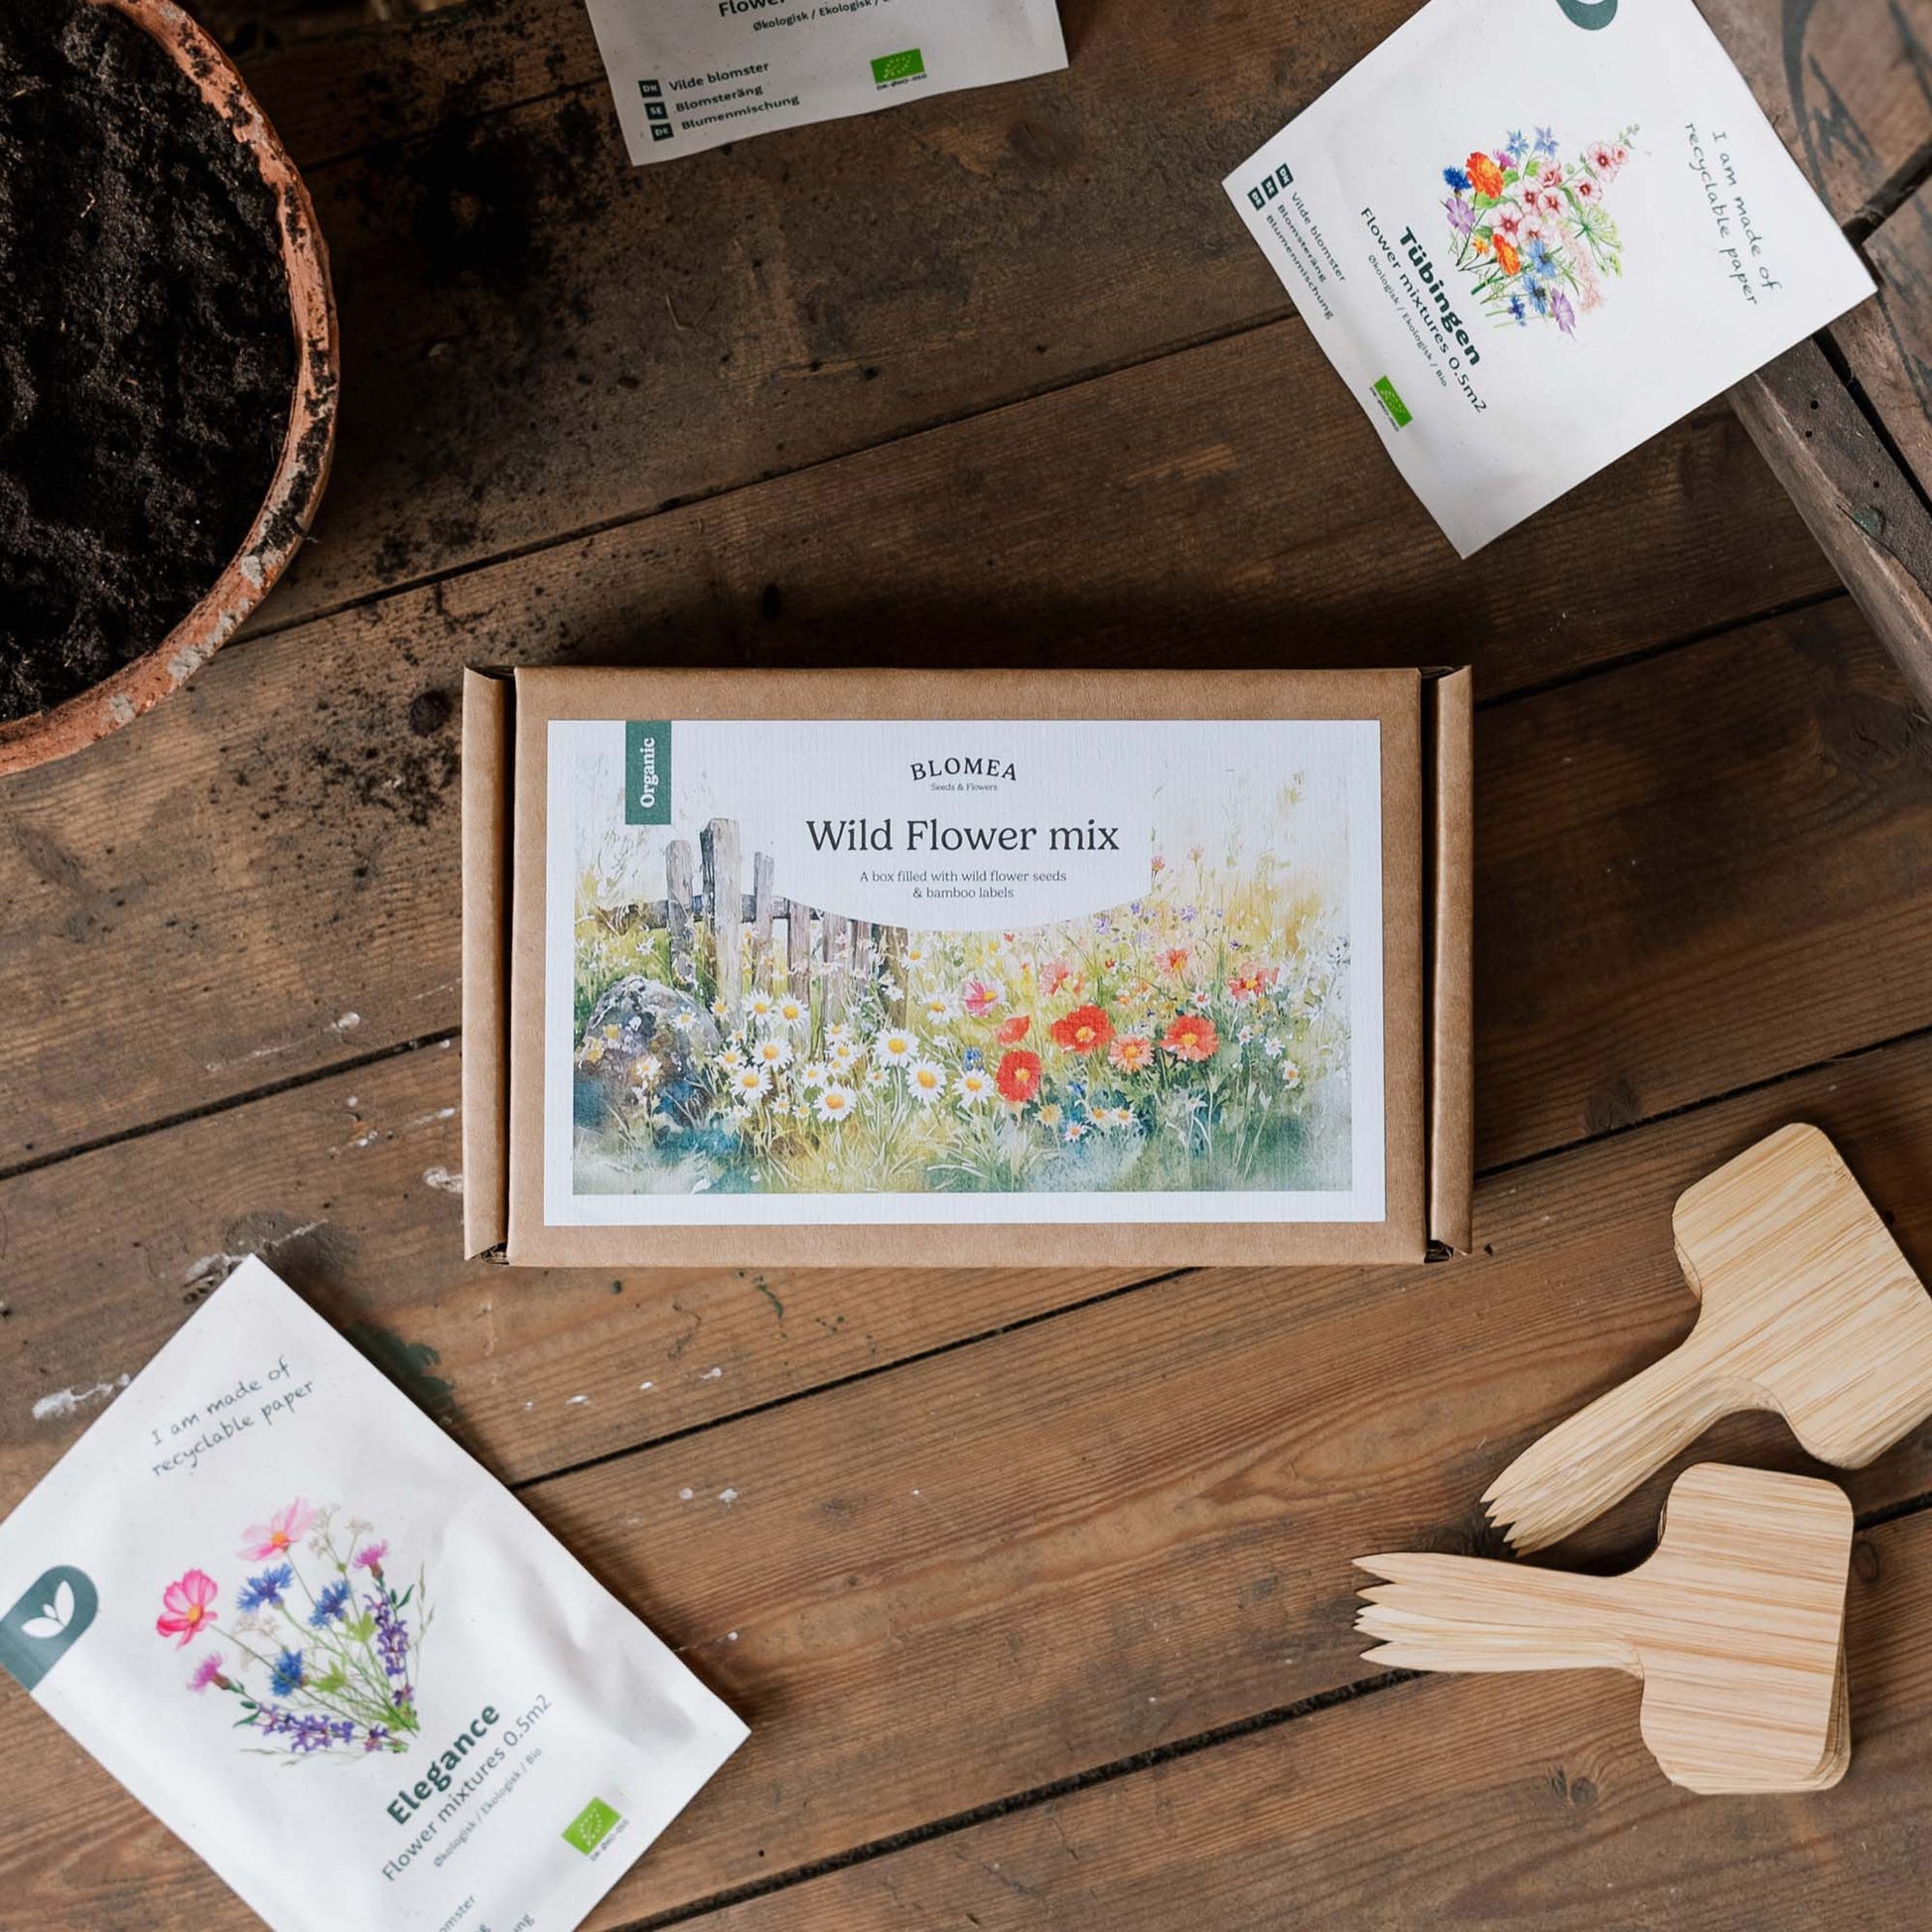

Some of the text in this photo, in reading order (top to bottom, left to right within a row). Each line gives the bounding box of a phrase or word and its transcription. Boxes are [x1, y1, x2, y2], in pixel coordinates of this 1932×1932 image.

[719, 0, 784, 17] Flowe
[753, 11, 808, 31] Økologisk
[811, 9, 816, 20] /
[819, 0, 872, 16] Ekologisk
[669, 76, 704, 91] Vilde
[707, 63, 769, 83] blomster
[675, 85, 763, 112] Blomsteräng
[681, 95, 800, 130] Blumenmischung
[1278, 204, 1326, 283] Blomsteräng
[1292, 192, 1311, 224] Vilde
[1311, 226, 1345, 282] blomster
[1685, 123, 1757, 306] recyclable paper
[1713, 131, 1783, 291] I am made of
[1266, 214, 1334, 320] Blumenmischung
[1400, 226, 1480, 365] Tübingen
[1361, 207, 1487, 413] Flower mixtures 0.5m2
[1368, 254, 1400, 306] Økologisk
[1402, 313, 1434, 362] Ekologisk
[1436, 368, 1448, 387] Bio
[639, 737, 659, 808] Organic
[910, 757, 1017, 781] BLOMEA
[930, 782, 998, 791] Seeds & Flowers
[806, 818, 1120, 851] Wild Flower mix
[860, 871, 1066, 882] A box filled with wild flower seeds
[912, 887, 1014, 898] & bamboo labels
[151, 1354, 290, 1446] I am made of
[152, 1381, 314, 1476] recyclable paper
[382, 1694, 552, 1881] Flower mixtures 0.5m2
[386, 1705, 499, 1825] Elegance
[434, 1821, 477, 1867] Økologisk
[477, 1813, 483, 1824] /
[481, 1771, 521, 1814] Ekologisk
[526, 1748, 542, 1765] Bio
